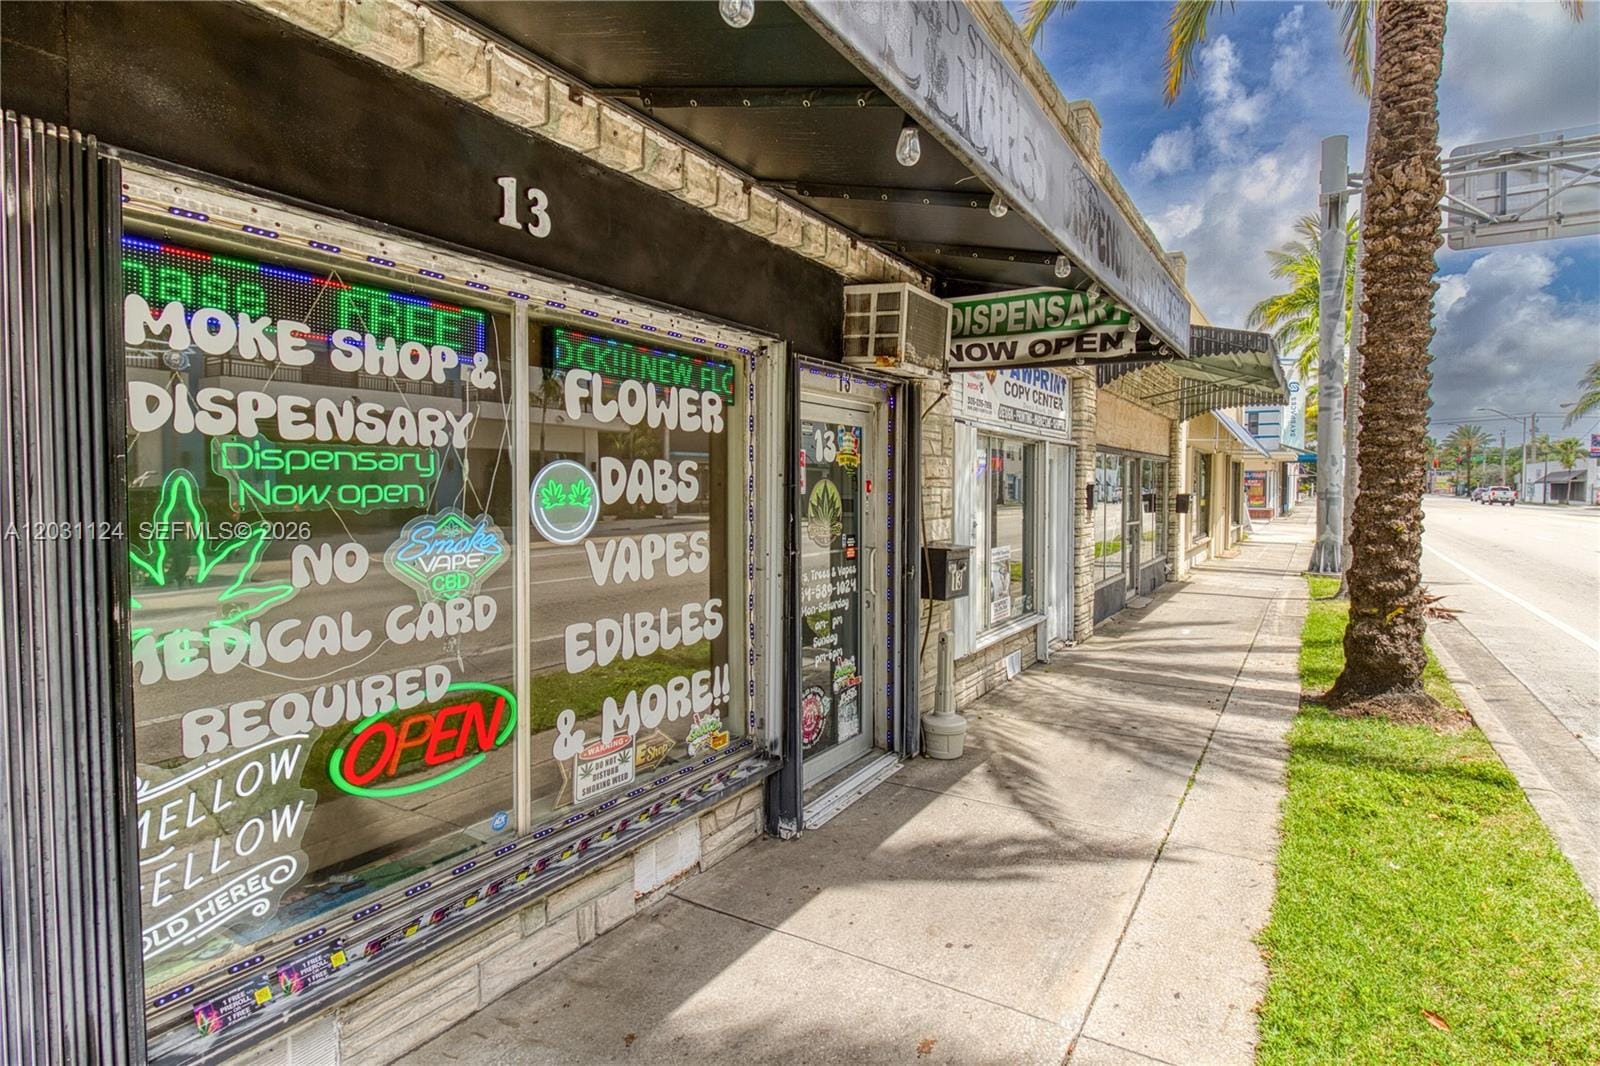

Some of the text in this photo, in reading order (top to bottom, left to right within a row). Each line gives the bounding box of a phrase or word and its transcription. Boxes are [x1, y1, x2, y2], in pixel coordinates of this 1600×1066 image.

[497, 177, 551, 238] 13
[338, 290, 462, 350] FREE
[330, 329, 459, 384] SHOP
[470, 352, 497, 390] &
[950, 332, 1125, 362] NOW OPEN
[565, 369, 724, 433] FLOWER
[1000, 368, 1066, 396] AWPRINT
[1004, 380, 1030, 401] COPY
[1032, 390, 1064, 411] CENTER
[127, 381, 473, 448] DISPENSARY
[220, 440, 436, 478] Dispensary
[814, 428, 837, 463] 13
[237, 478, 426, 510] Now open
[601, 457, 699, 505] DABS
[396, 520, 504, 562] Smoke
[585, 531, 709, 586] VAPES
[291, 543, 368, 588] NO
[418, 552, 486, 573] VAPE
[432, 572, 471, 592] CBD
[837, 564, 856, 578] Vapes
[131, 597, 498, 685] MEDICAL CARD
[565, 599, 724, 674] EDIBLES
[813, 633, 838, 648] Sunday
[181, 664, 453, 758] REQUIRED
[553, 663, 730, 761] & MORE!!
[343, 696, 506, 786] OPEN
[647, 744, 669, 762] Shop
[592, 766, 619, 782] DISTURB
[595, 755, 617, 770] DO NOT
[582, 772, 629, 797] SMOKING WEED
[140, 800, 304, 907] ELLOW
[195, 875, 262, 922] HERE
[228, 991, 246, 1003] FREE
[233, 1007, 251, 1020] FREE
